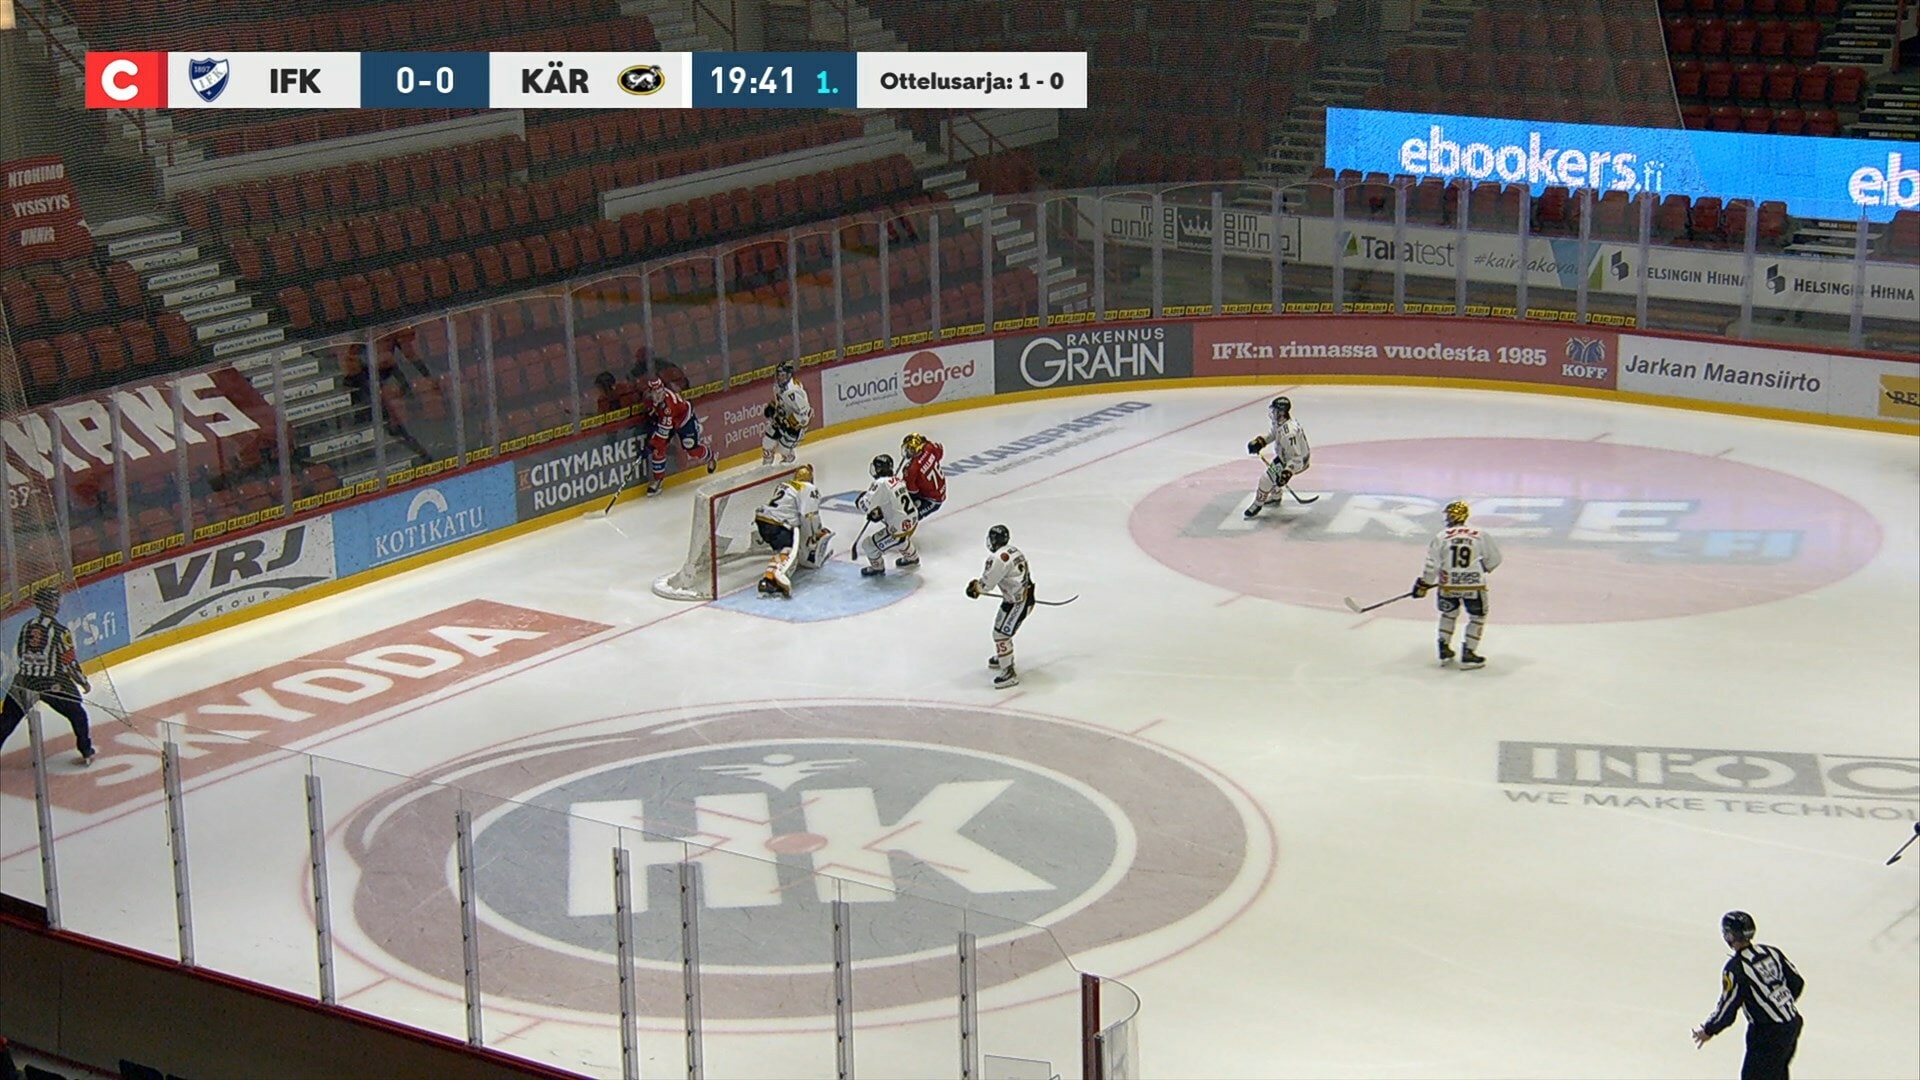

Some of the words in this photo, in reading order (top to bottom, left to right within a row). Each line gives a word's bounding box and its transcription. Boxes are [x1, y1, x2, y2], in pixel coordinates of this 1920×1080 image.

[1871, 284, 1915, 301] HIHNA
[1066, 327, 1165, 346] RAKENNUS
[1019, 336, 1165, 388] GRAHN
[1212, 343, 1272, 360] IFK:n
[1279, 341, 1378, 360] rinnassa
[1385, 342, 1490, 362] vuodesta
[1497, 346, 1547, 366] 1985
[838, 372, 898, 401] Lounari
[902, 360, 975, 388] Edenred
[1561, 363, 1608, 379] KOFF
[1625, 354, 1696, 381] Jarkan
[1703, 362, 1821, 392] Maansiirto
[375, 506, 484, 558] KOTIKATU
[153, 525, 306, 603] VRJ
[1450, 545, 1471, 568] 19
[199, 590, 270, 618] GROUP
[43, 622, 550, 787] SKYDDA
[1504, 789, 1568, 806] WE
[1583, 793, 1706, 812] MAKE
[565, 778, 1058, 918] HK
